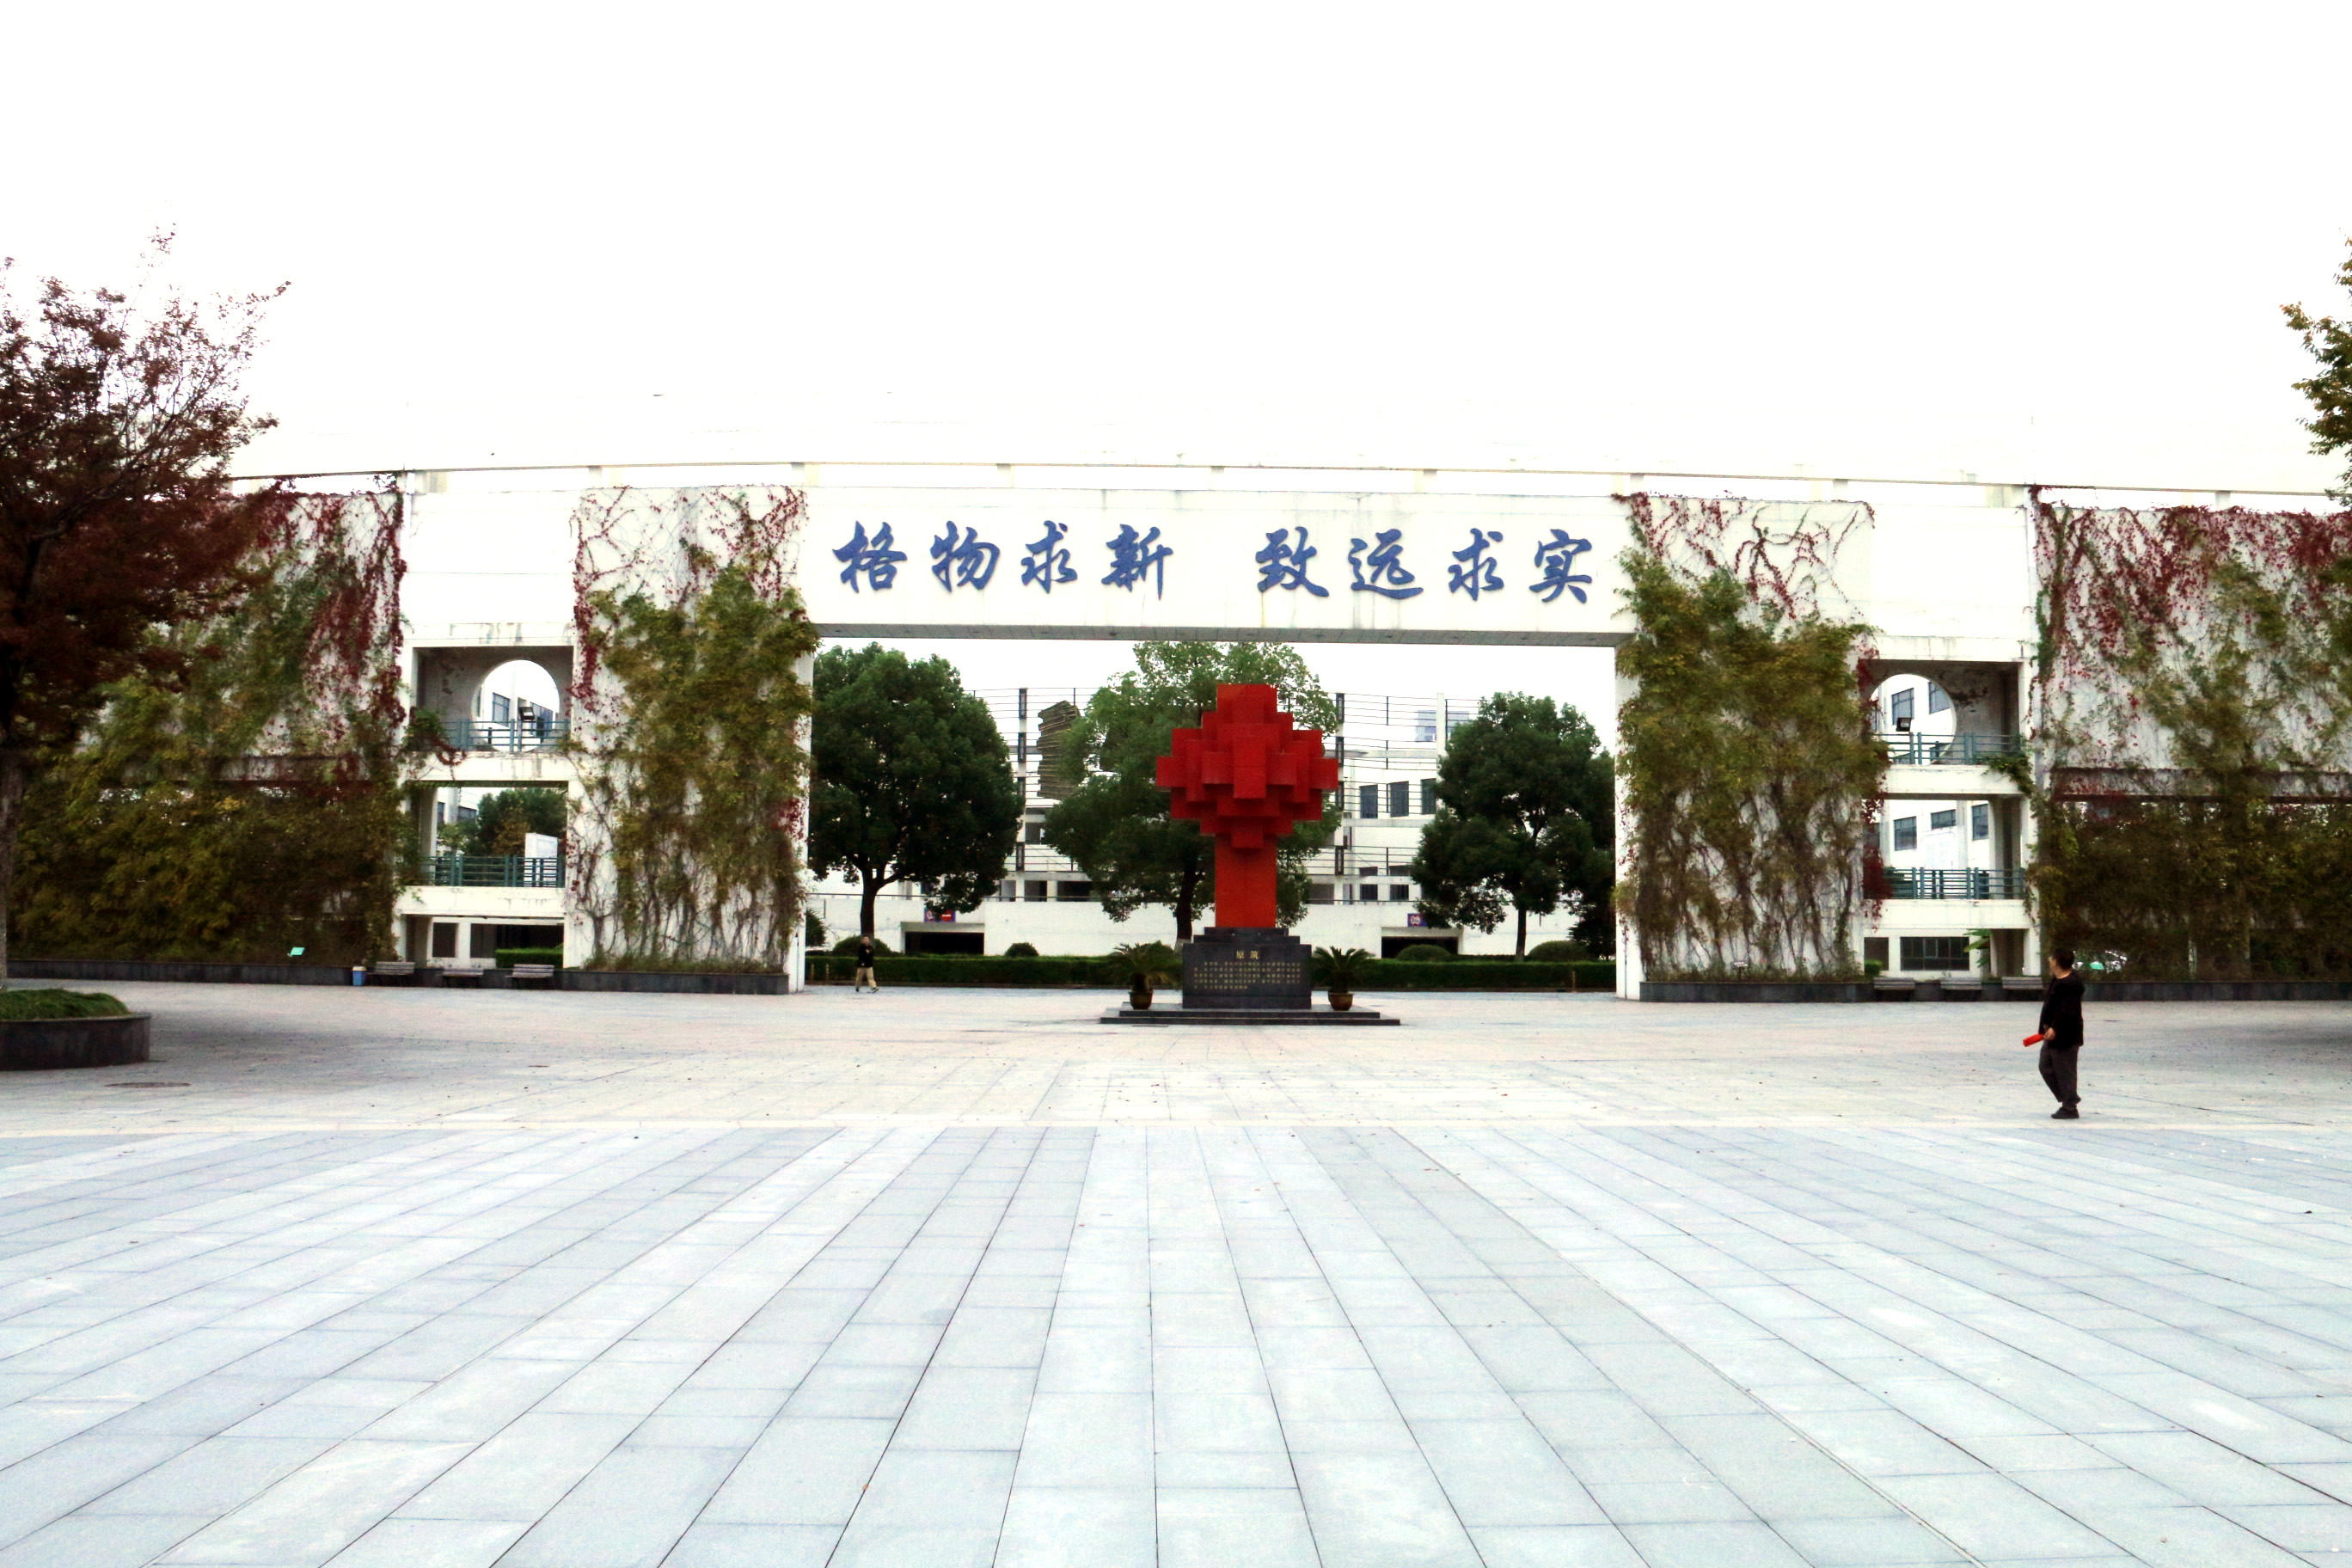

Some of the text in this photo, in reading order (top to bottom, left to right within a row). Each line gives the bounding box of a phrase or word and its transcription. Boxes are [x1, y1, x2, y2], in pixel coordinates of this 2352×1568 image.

[833, 520, 1591, 602] 格物求新 致远求实
